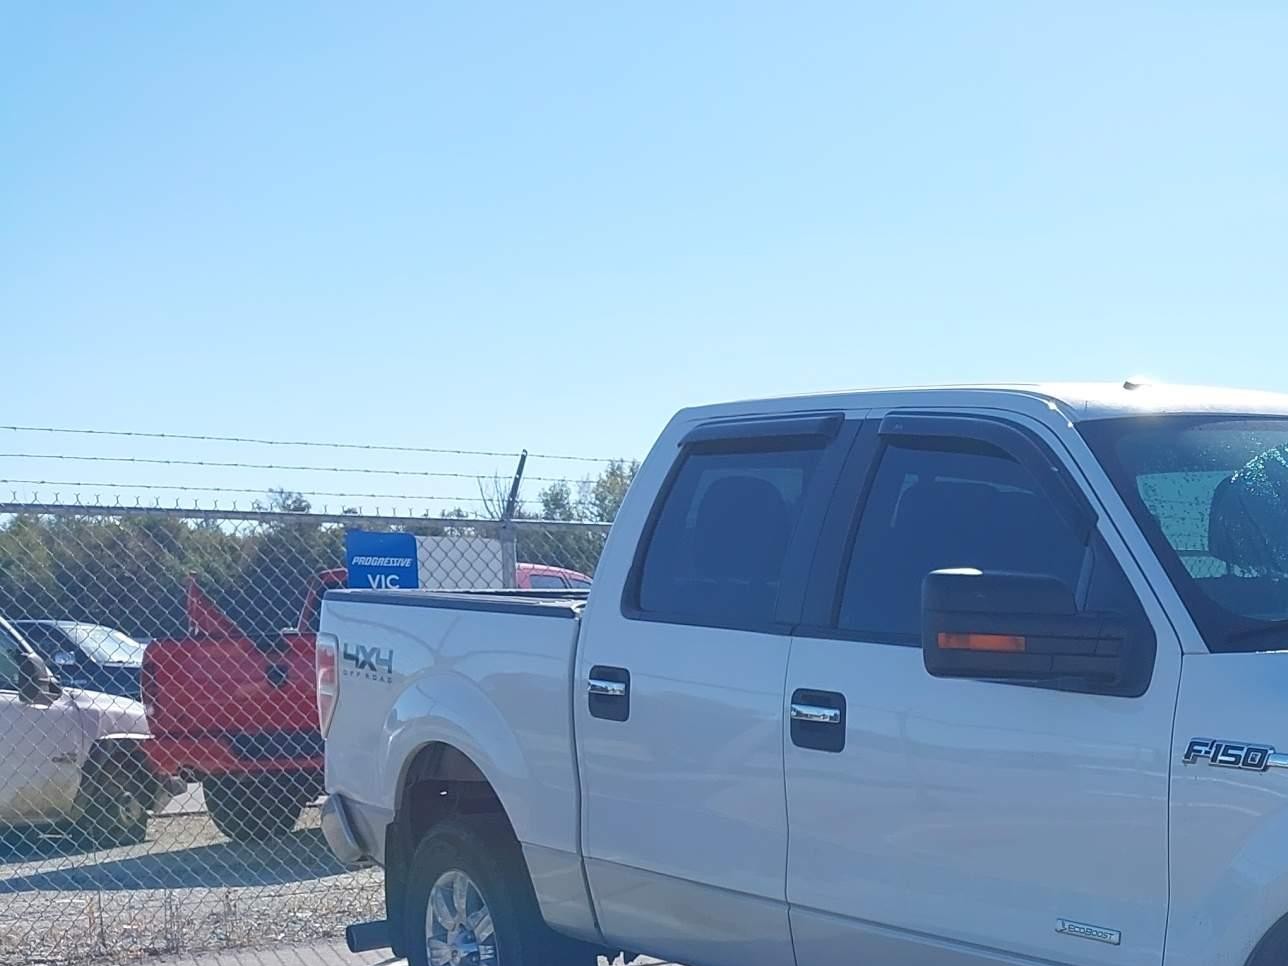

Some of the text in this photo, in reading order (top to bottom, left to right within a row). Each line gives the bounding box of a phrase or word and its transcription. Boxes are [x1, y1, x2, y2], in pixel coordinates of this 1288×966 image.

[352, 556, 413, 567] PROGRESSIVE
[367, 574, 400, 589] VIC
[1182, 738, 1275, 771] F-150
